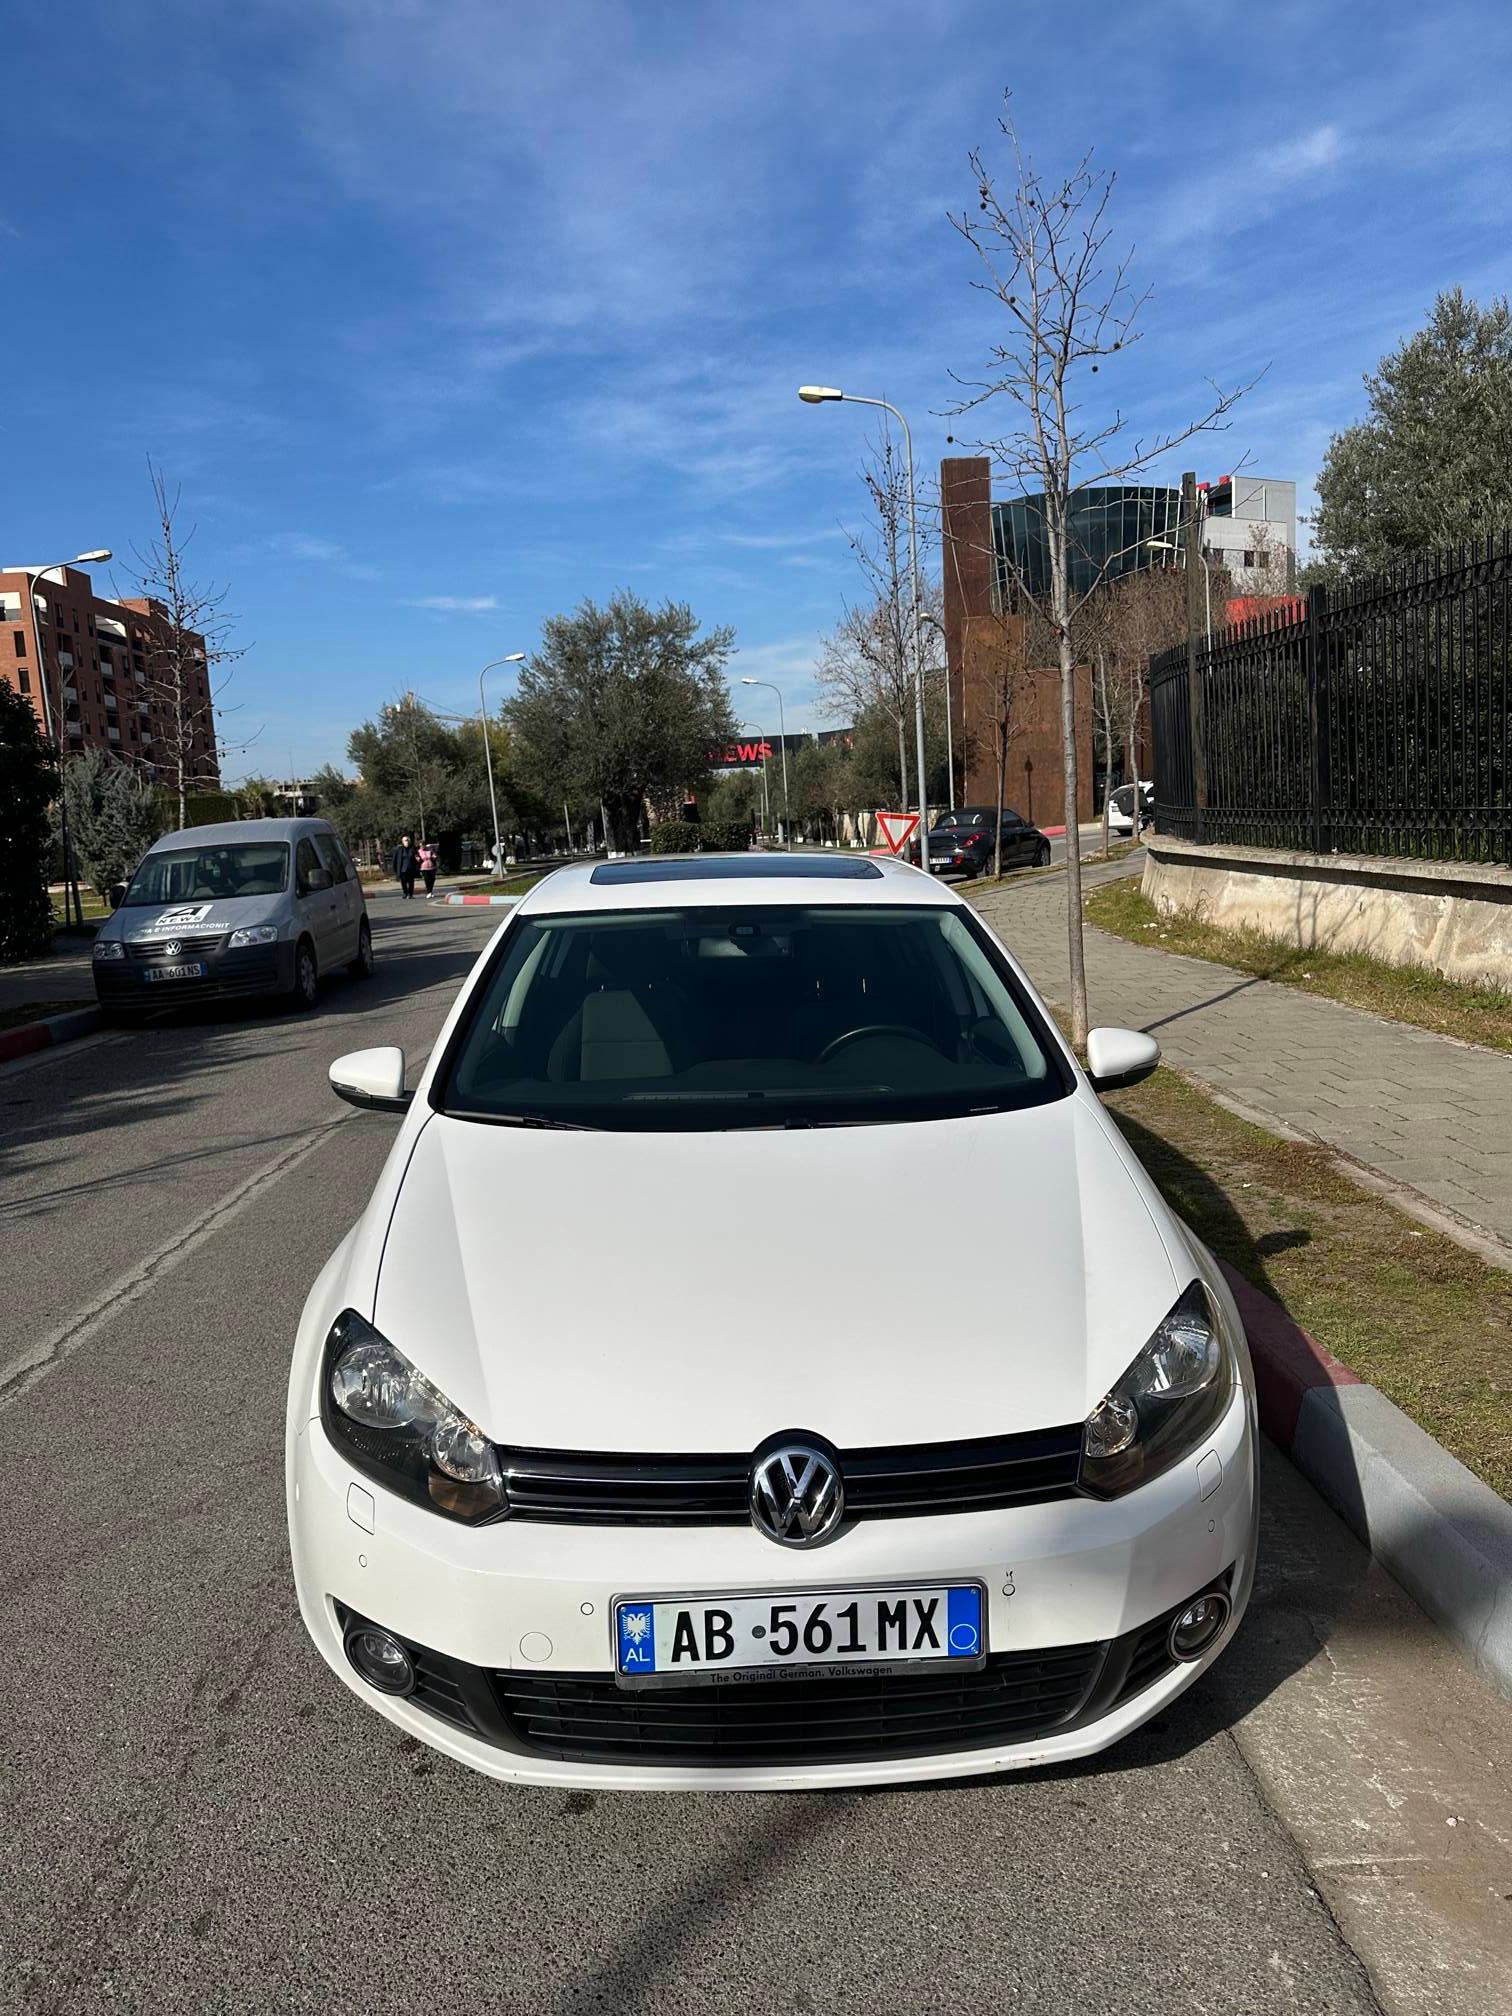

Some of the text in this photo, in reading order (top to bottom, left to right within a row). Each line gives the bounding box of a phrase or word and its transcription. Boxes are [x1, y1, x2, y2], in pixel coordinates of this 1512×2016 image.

[706, 742, 774, 763] EWS
[158, 915, 202, 924] NEWS
[671, 1609, 735, 1663] AB
[625, 1648, 651, 1663] AL
[710, 1673, 730, 1684] The
[732, 1669, 776, 1683] Original
[828, 1665, 892, 1679] Volkswagen
